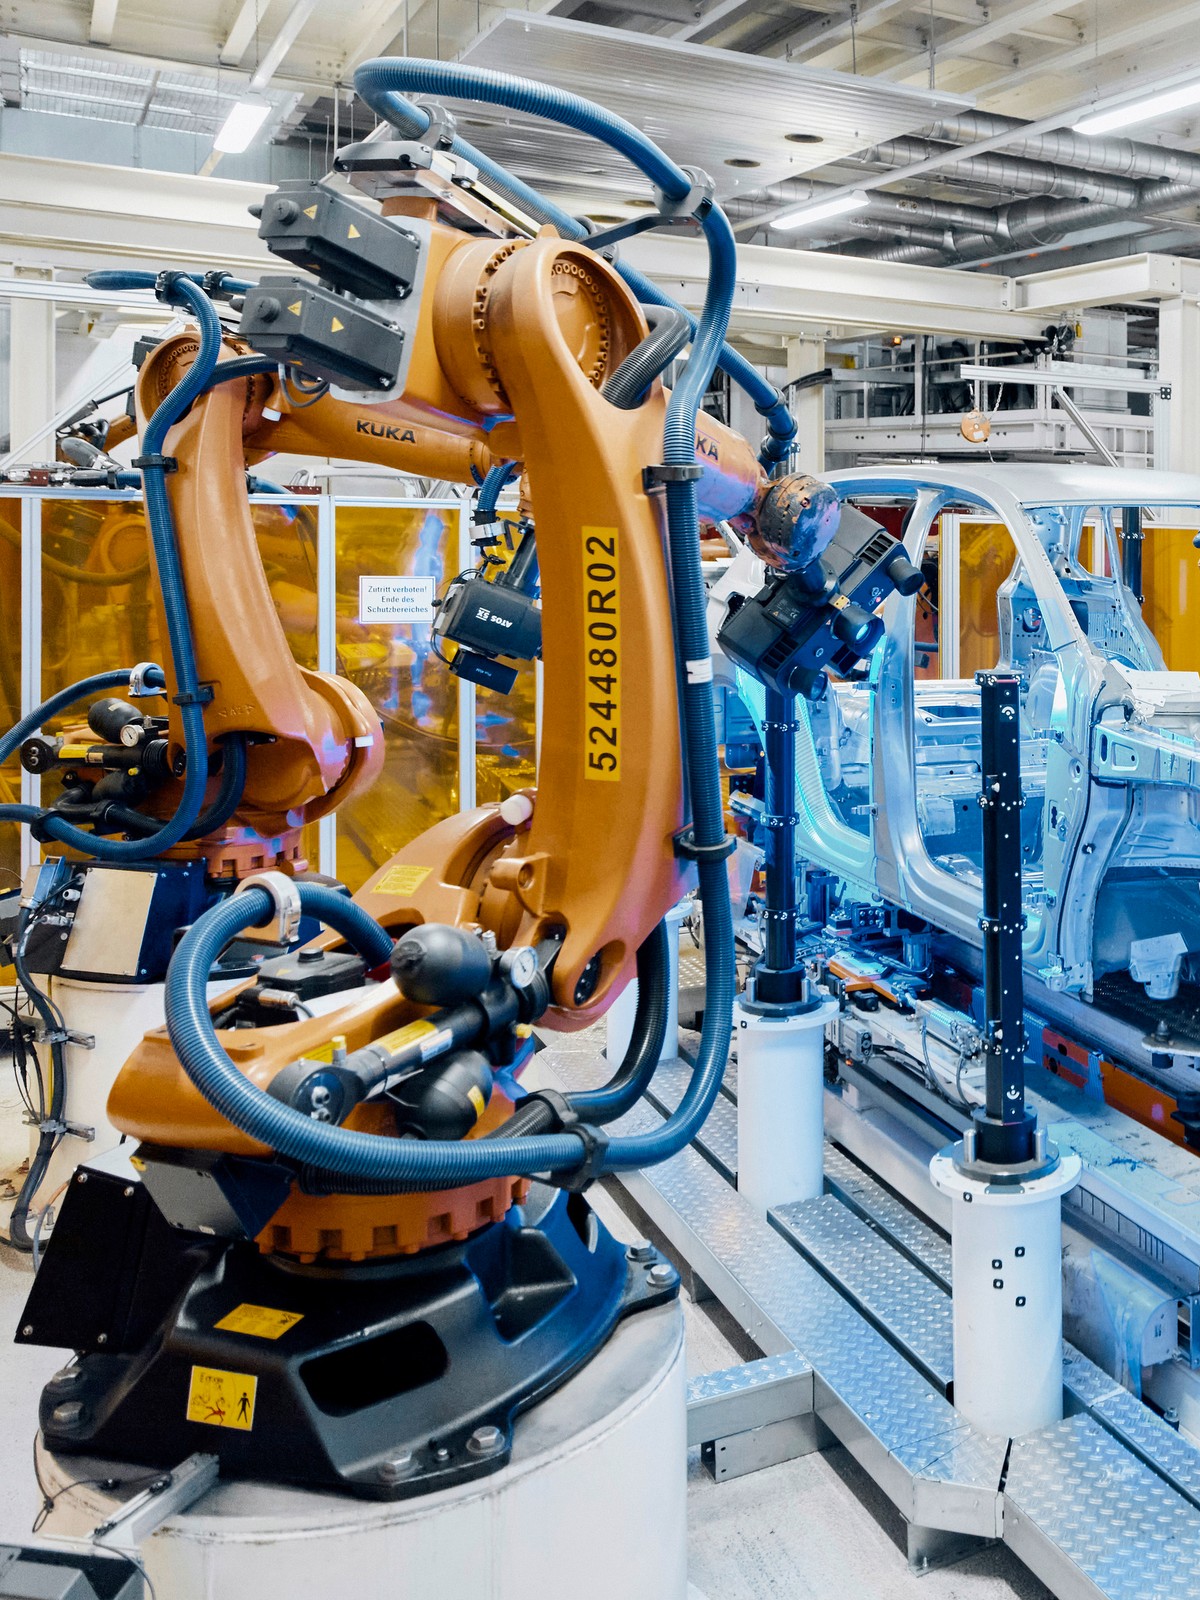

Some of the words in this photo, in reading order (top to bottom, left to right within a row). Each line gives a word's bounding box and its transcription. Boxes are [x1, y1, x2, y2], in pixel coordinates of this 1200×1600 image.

[356, 419, 416, 443] KUKA
[696, 433, 719, 461] KA
[367, 585, 391, 593] Zutritt
[392, 585, 427, 593] verboten!
[381, 595, 400, 603] Ende
[401, 595, 415, 603] des
[367, 605, 429, 613] Schutzbereiches
[490, 615, 513, 628] ATOS
[585, 535, 617, 772] 524480R02
